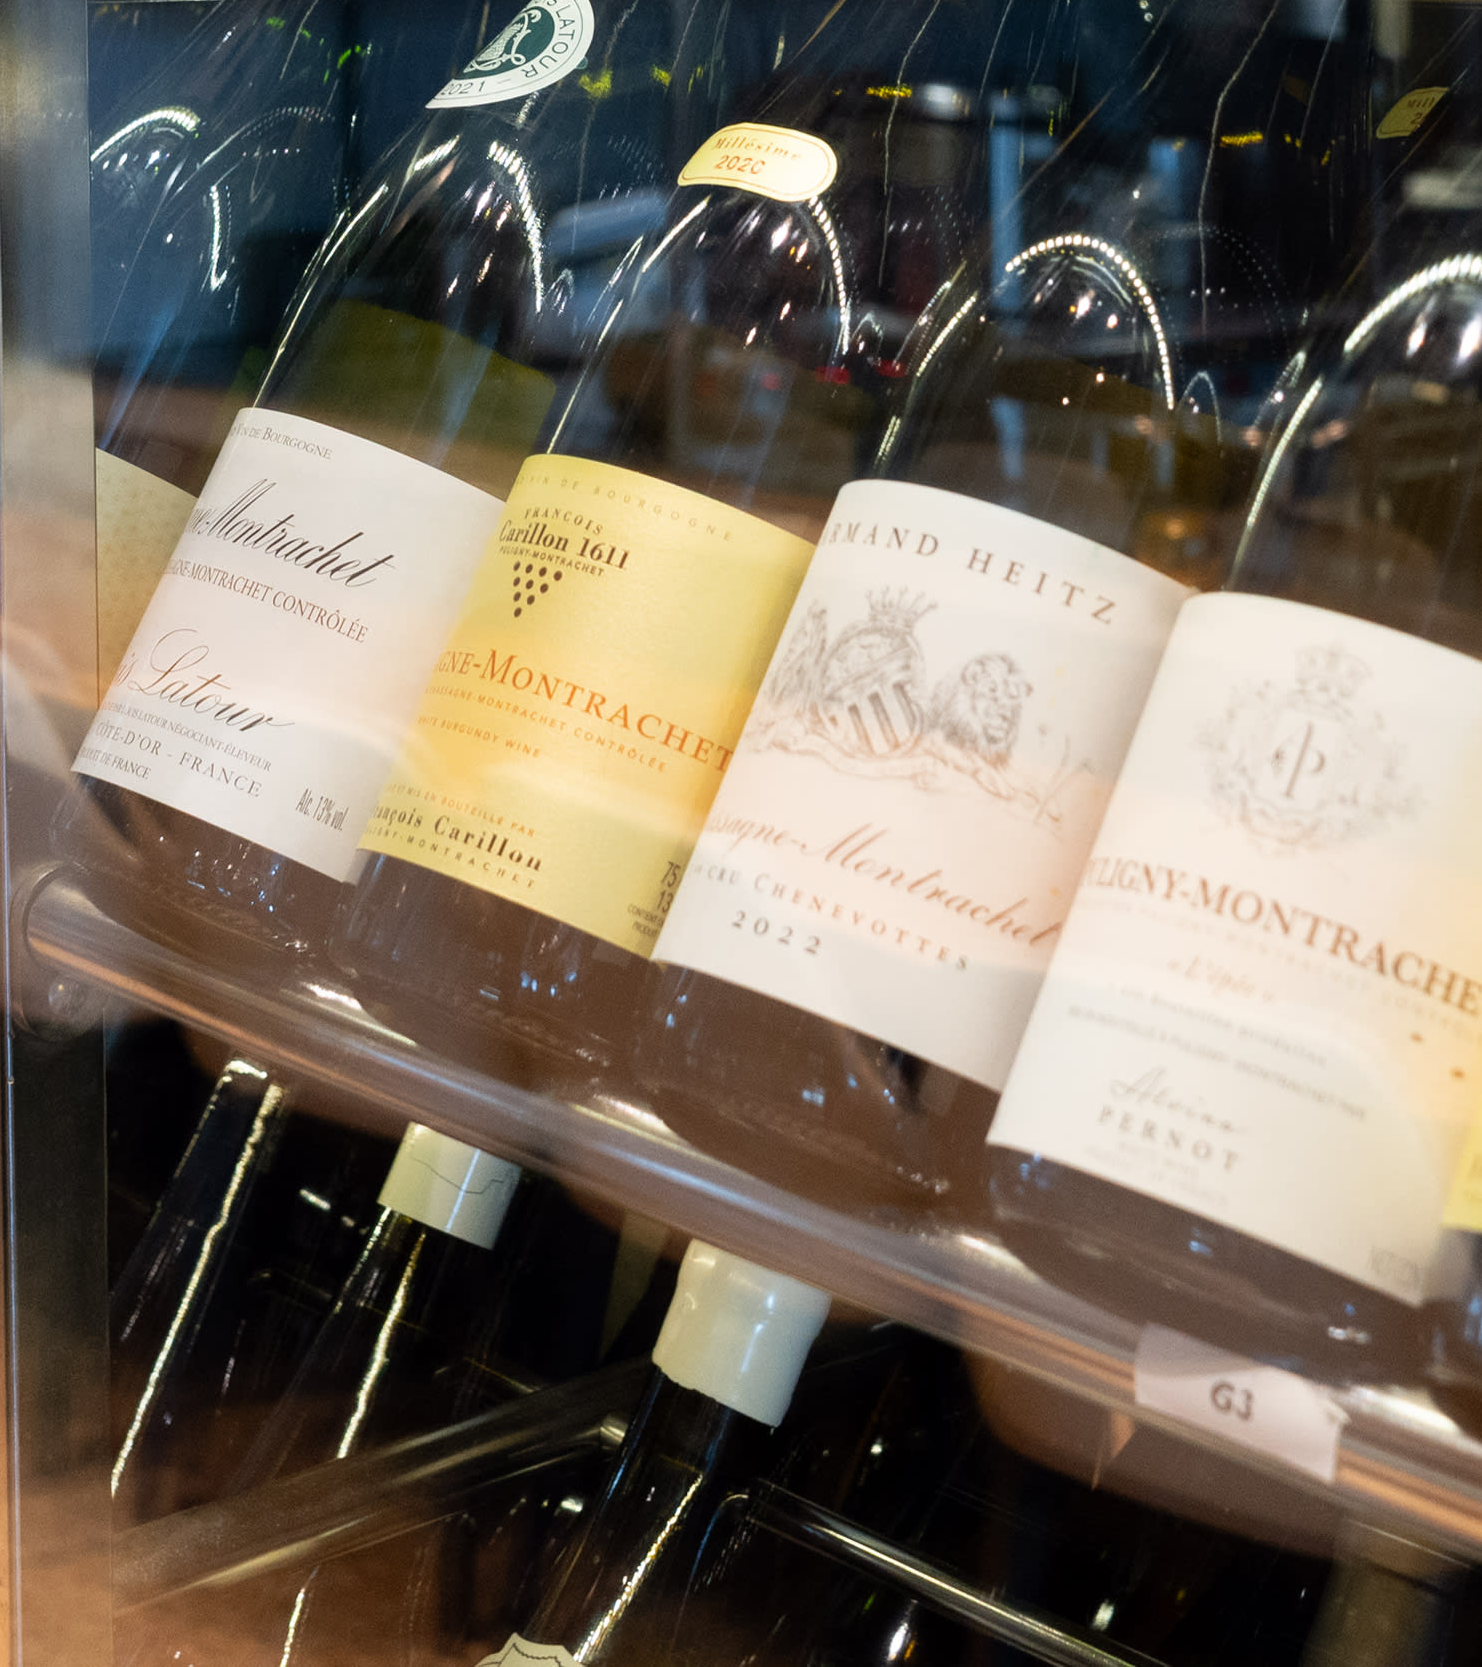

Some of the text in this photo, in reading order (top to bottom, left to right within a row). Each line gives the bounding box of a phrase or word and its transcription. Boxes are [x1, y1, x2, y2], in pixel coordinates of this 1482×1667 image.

[521, 3, 578, 79] LATOUR
[261, 426, 334, 460] BOURGOGNE
[498, 519, 632, 571] Carillon 1611
[965, 546, 1117, 626] HEITZ
[272, 589, 370, 645] CONTRÔLÉE
[126, 627, 296, 732] Latour
[111, 754, 153, 781] FRANCE
[168, 720, 272, 773] NÉGOCIANT-ÉLEVEUR
[504, 737, 542, 760] WINE
[573, 726, 667, 774] CONTRÔLÉE
[177, 750, 263, 798] FRANCE
[433, 813, 543, 873] Carillon
[731, 908, 824, 957] 2022
[753, 871, 970, 972] CHENEVOTTES
[1097, 1104, 1240, 1173] PERNOT
